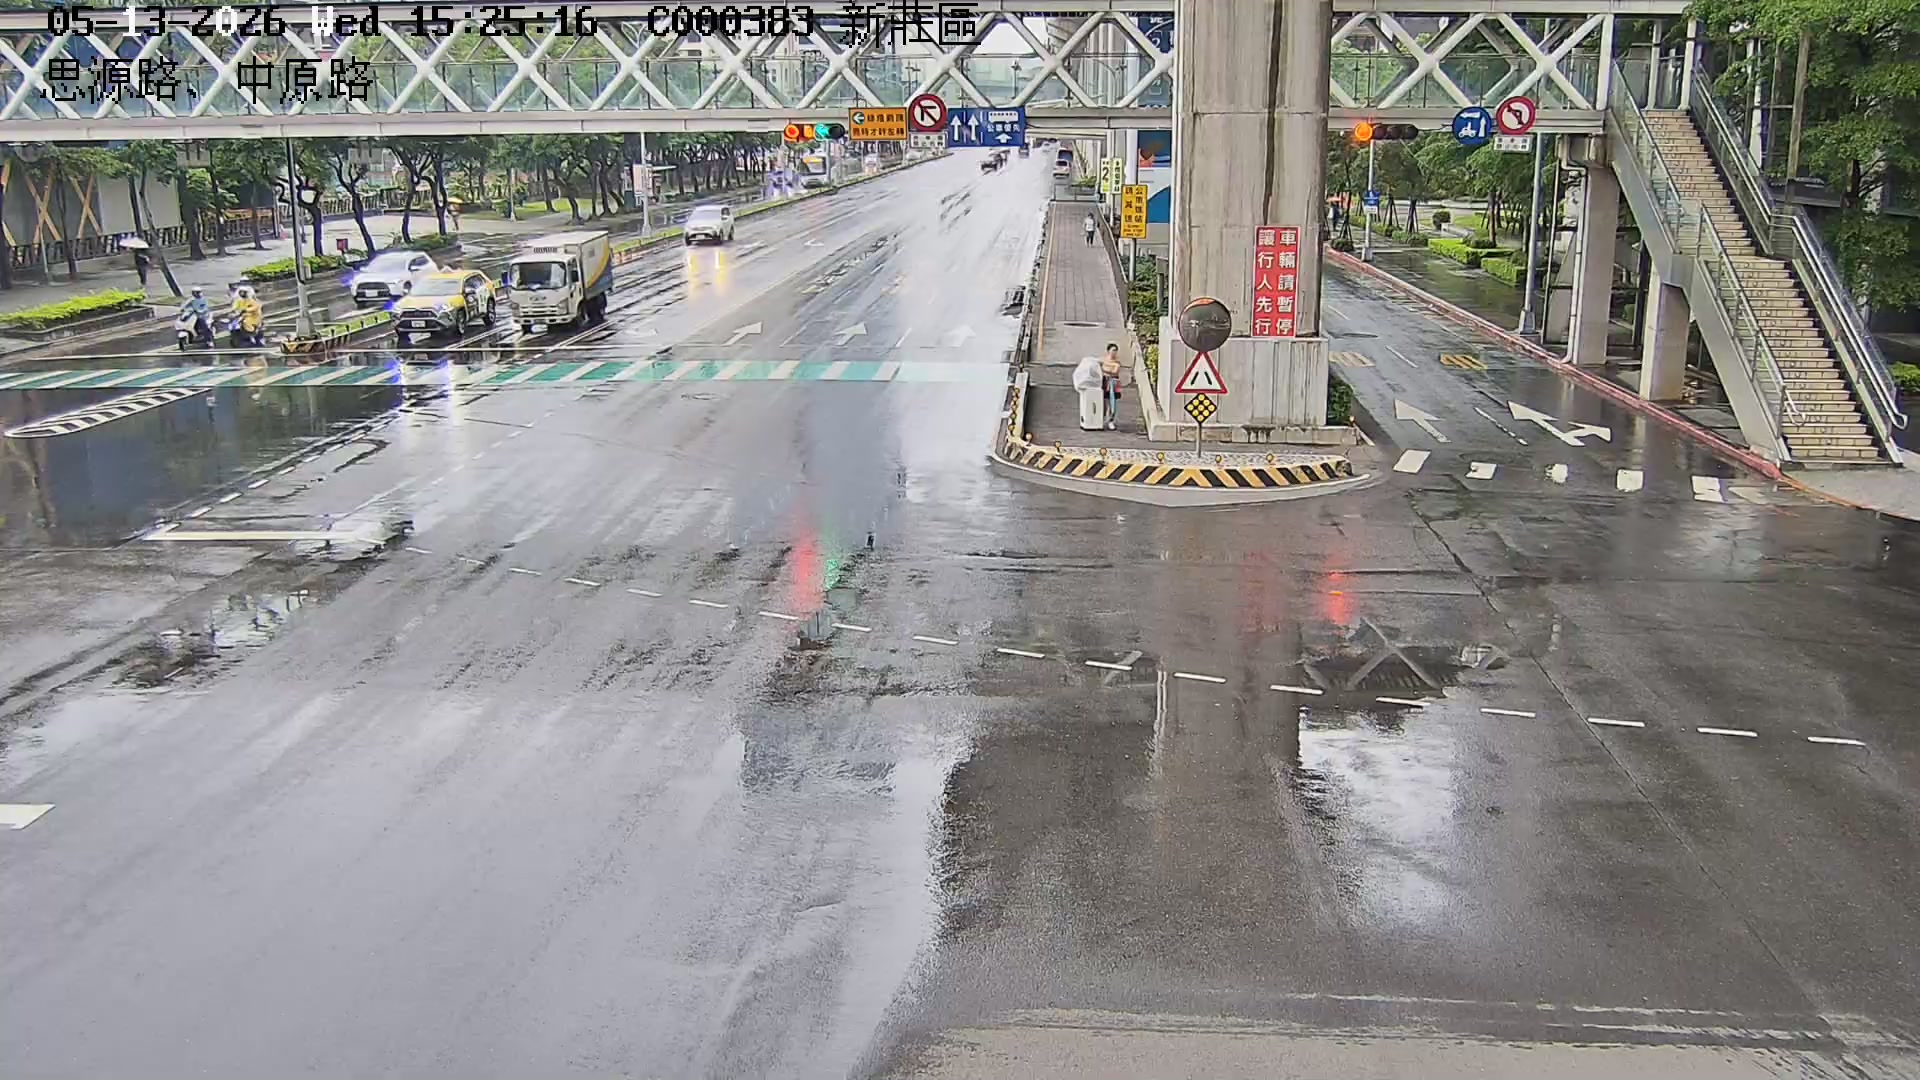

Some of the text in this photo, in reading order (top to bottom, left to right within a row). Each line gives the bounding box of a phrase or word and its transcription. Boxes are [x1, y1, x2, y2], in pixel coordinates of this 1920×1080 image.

[1255, 229, 1276, 336] 讓行人先行
[1276, 229, 1297, 336] 車輛請暫停
